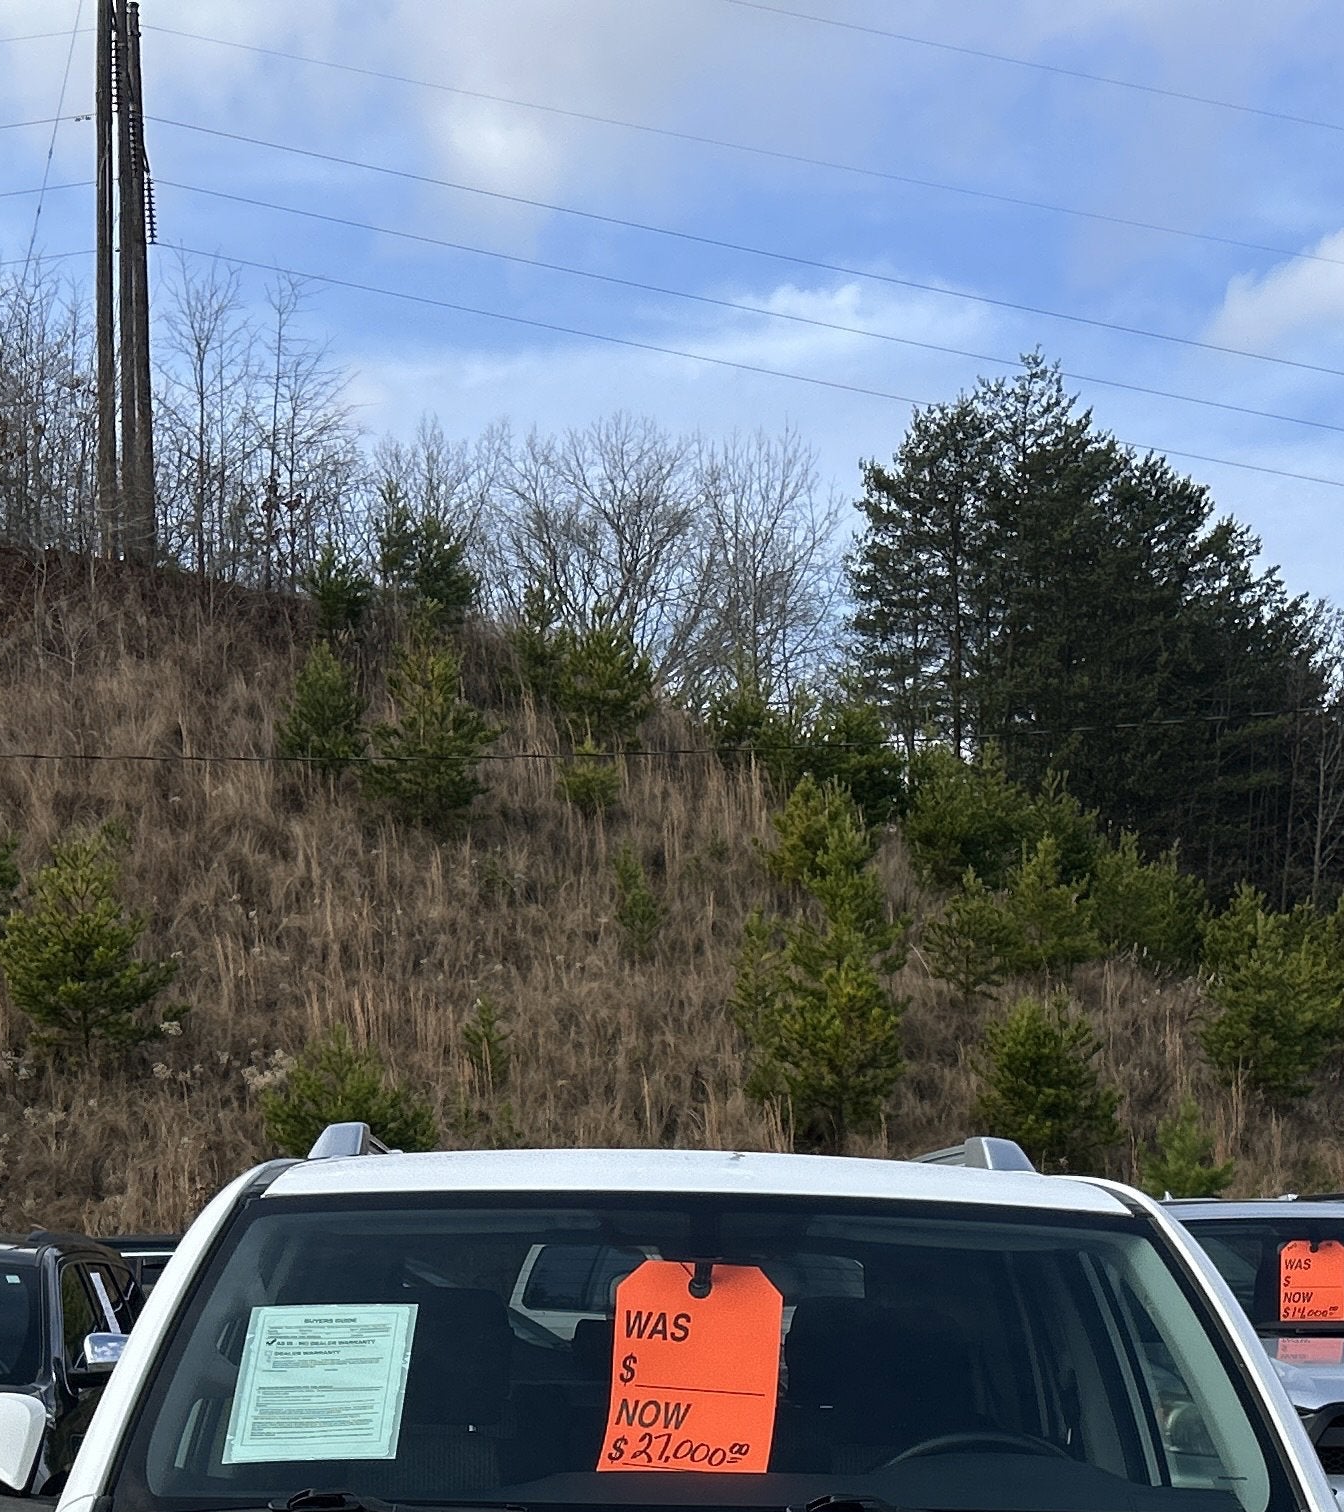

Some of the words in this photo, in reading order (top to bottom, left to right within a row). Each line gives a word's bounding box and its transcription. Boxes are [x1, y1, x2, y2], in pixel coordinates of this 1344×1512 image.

[1285, 1259, 1312, 1271] WAS
[1283, 1292, 1313, 1304] NOW
[625, 1309, 691, 1342] WAS
[619, 1352, 637, 1386] $
[615, 1398, 692, 1429] NOW
